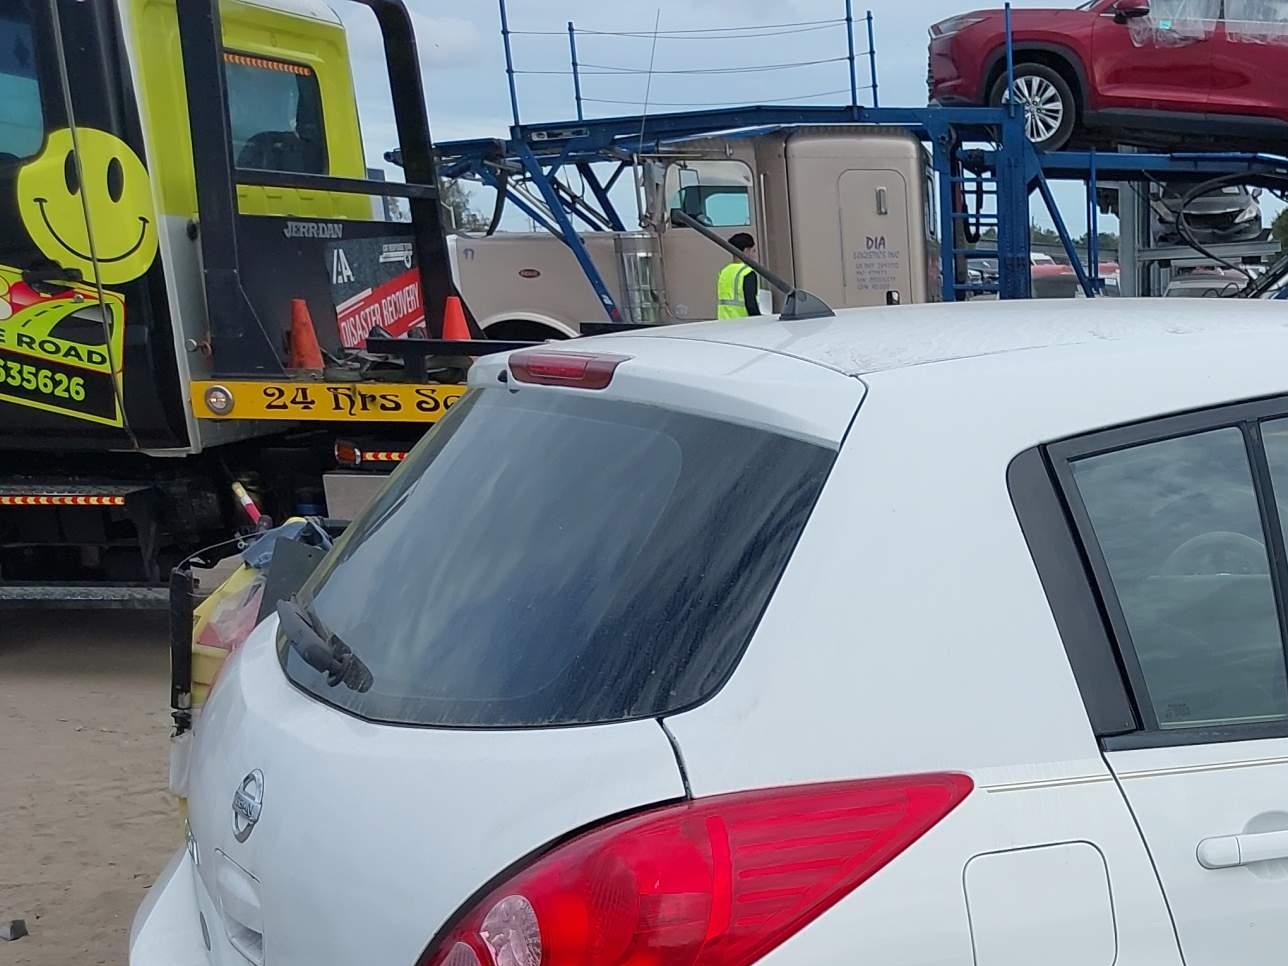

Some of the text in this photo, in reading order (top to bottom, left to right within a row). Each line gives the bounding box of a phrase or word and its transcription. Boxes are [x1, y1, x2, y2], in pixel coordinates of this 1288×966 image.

[865, 235, 886, 250] DIA
[341, 282, 421, 348] DISASTER RECOVERY
[16, 333, 108, 366] ROAD
[263, 386, 316, 410] 24
[327, 387, 403, 416] Hrs
